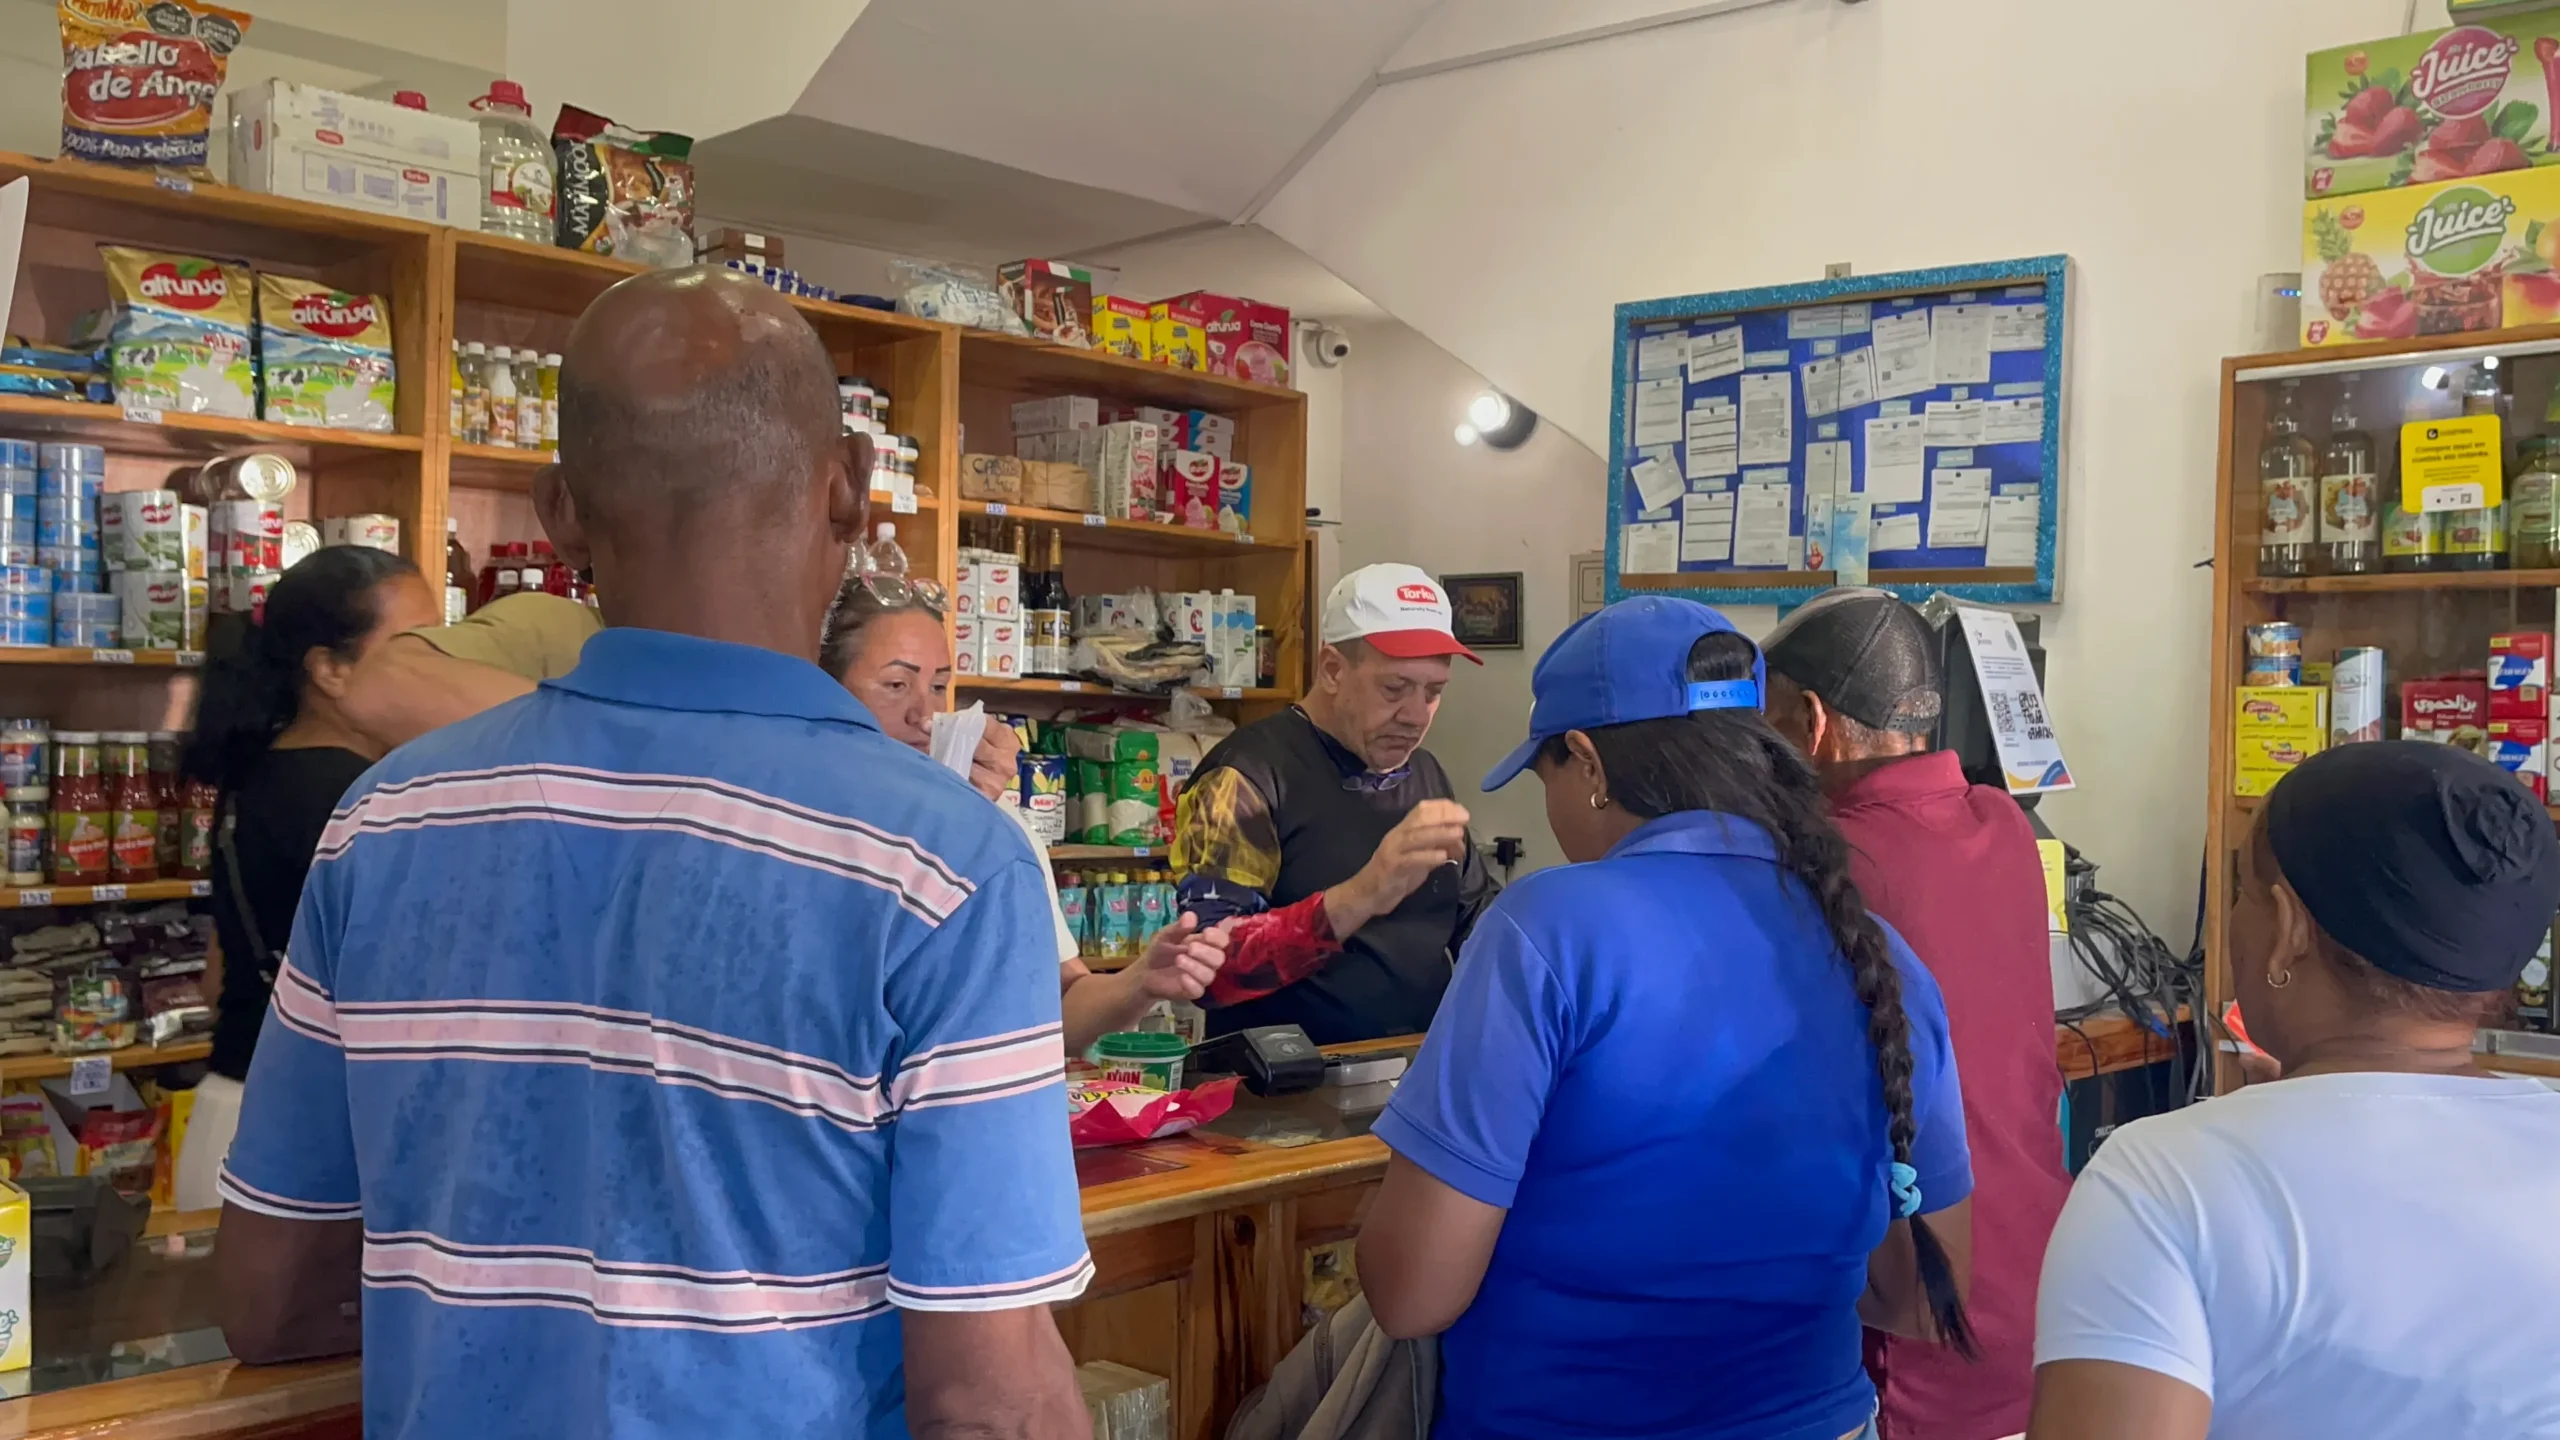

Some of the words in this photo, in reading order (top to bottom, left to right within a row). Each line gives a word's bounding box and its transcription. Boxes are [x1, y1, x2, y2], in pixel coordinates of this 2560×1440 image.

[88, 70, 132, 101] de
[138, 70, 219, 107] Ange
[2411, 42, 2509, 98] Juice
[2407, 201, 2505, 255] Juice
[1400, 587, 1437, 601] Torku
